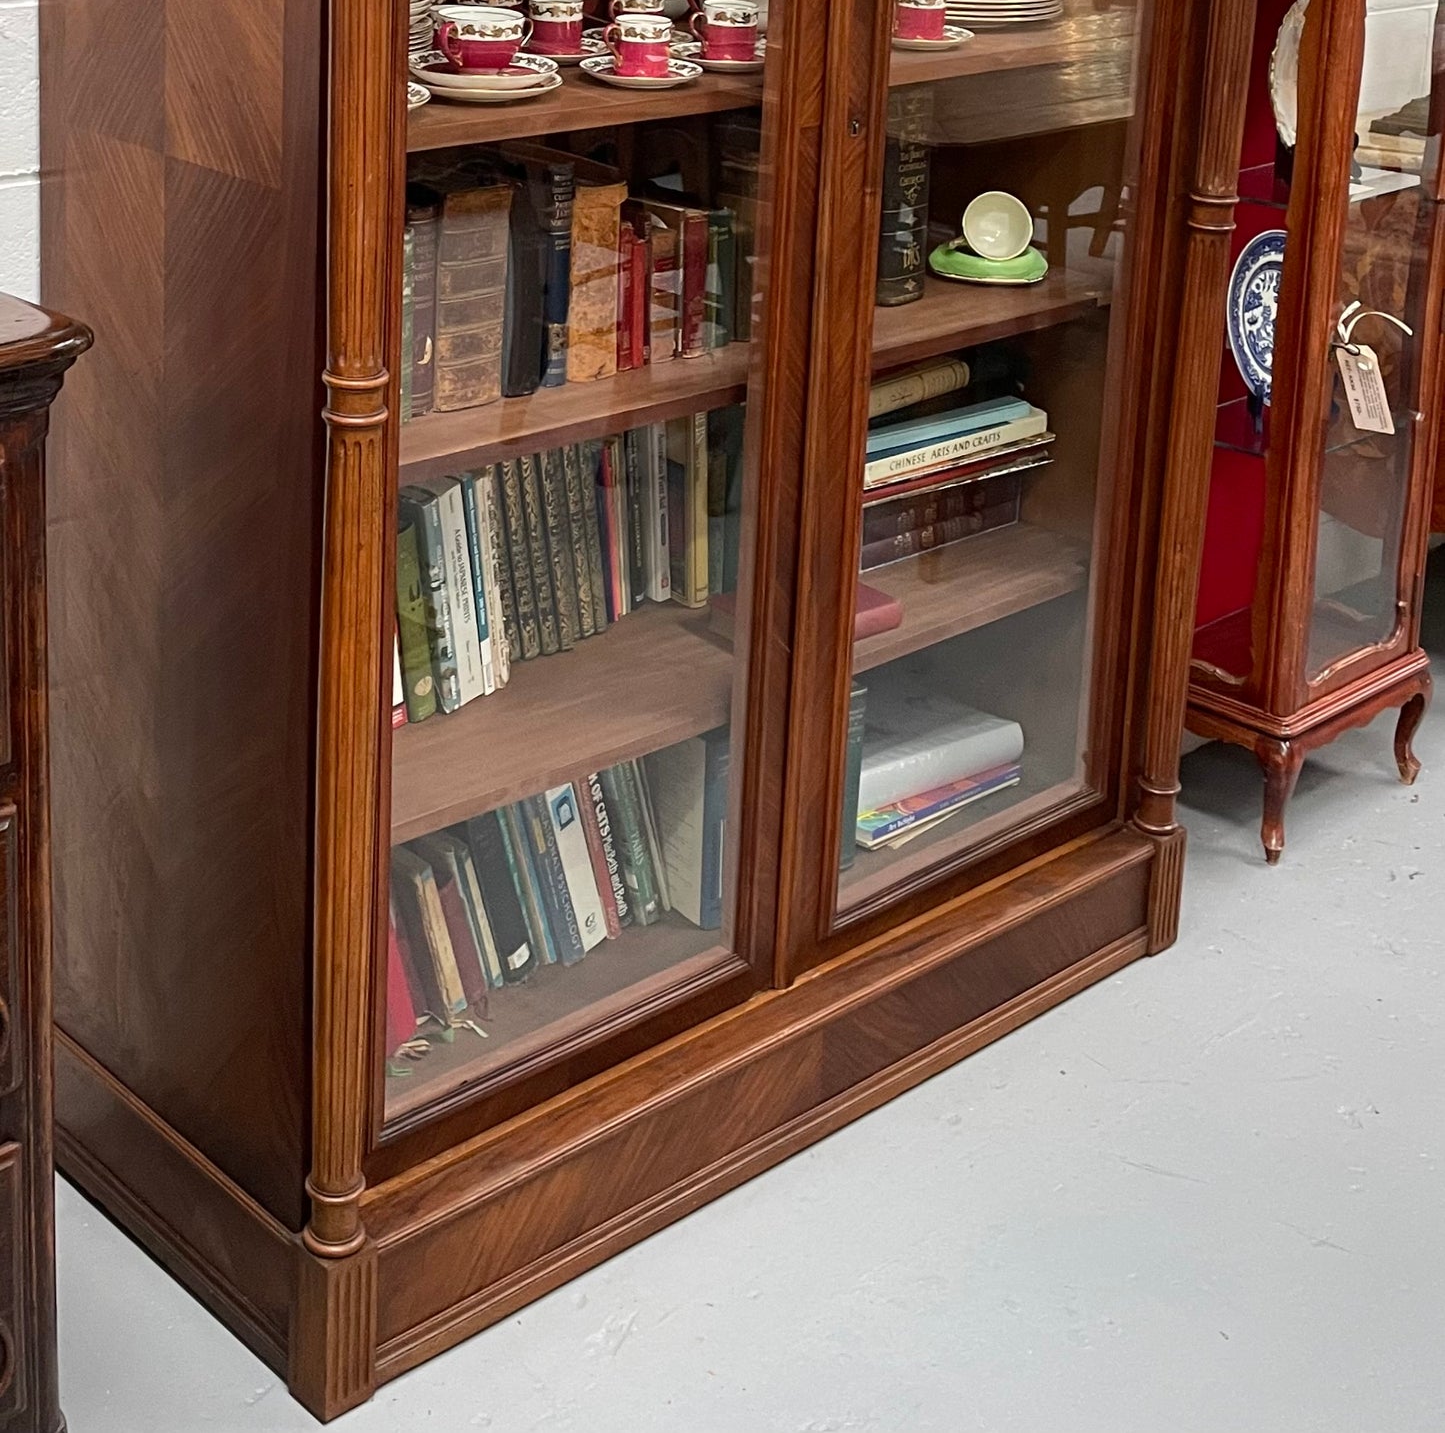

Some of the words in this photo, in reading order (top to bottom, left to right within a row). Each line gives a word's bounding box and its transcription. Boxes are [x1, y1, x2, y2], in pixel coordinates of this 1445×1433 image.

[889, 453, 927, 471] CHINESE
[929, 446, 950, 460] ARTS
[951, 439, 971, 453] AND
[972, 432, 1001, 447] CRAFTS
[593, 802, 611, 837] CATS
[602, 835, 619, 874] MacBeth
[614, 888, 628, 917] Booth
[556, 874, 581, 950] PSYCHOLOGY
